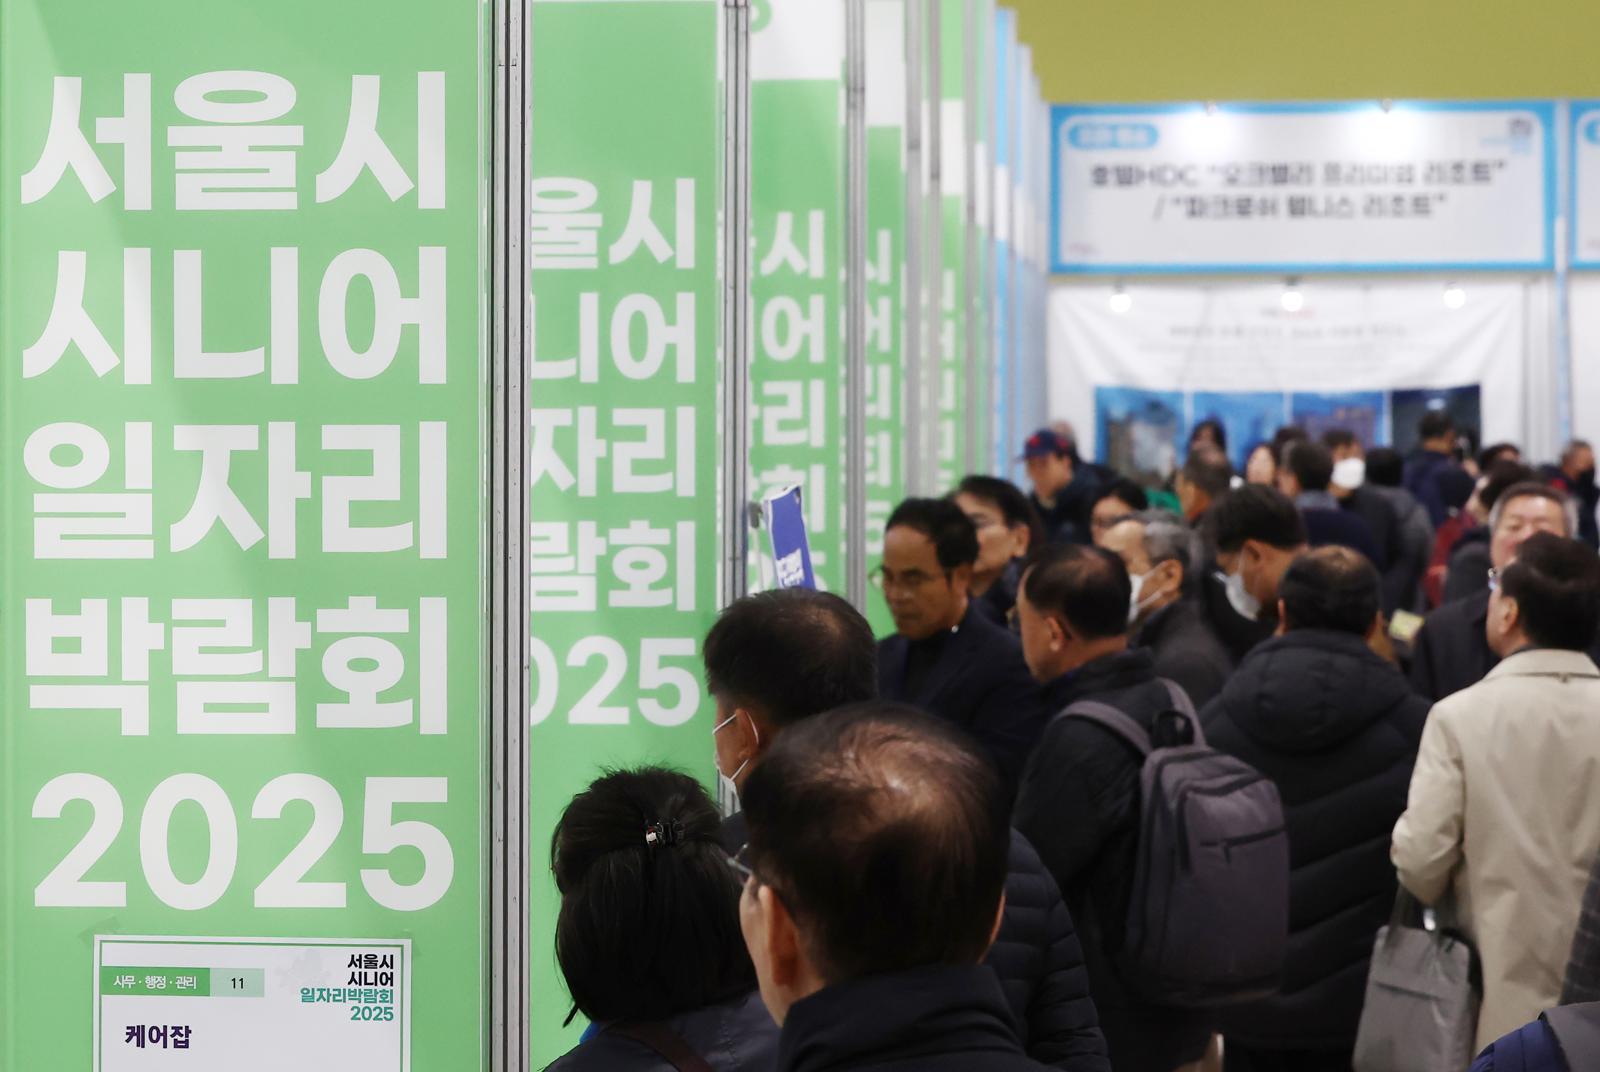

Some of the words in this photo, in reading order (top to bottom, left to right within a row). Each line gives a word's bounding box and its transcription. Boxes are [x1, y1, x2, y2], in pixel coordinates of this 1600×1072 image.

[20, 69, 447, 212] 서울시
[531, 176, 696, 269] 울시
[21, 245, 448, 385] 시니어
[531, 292, 696, 383] 니어
[23, 420, 448, 560] 일자리
[531, 406, 696, 497] 자리
[531, 520, 696, 611] 람회
[24, 595, 448, 736] 박람회
[31, 772, 455, 912] 2025
[231, 977, 244, 990] 11
[300, 987, 394, 1004] 일자리박람회
[347, 953, 394, 970] 서울시
[347, 971, 394, 987] 시니어
[125, 1025, 192, 1048] 케어잡
[350, 1005, 394, 1022] 2025
